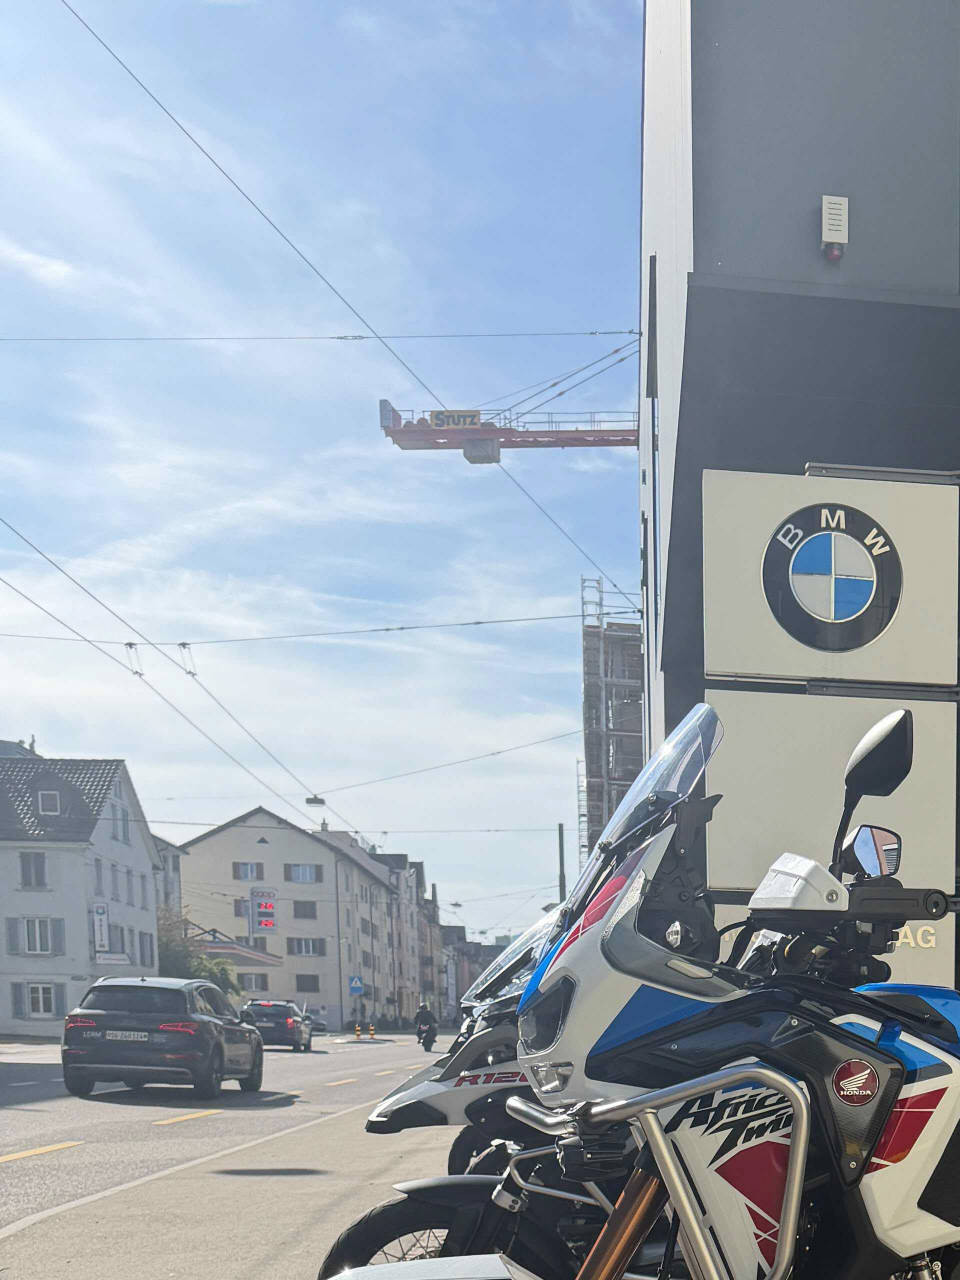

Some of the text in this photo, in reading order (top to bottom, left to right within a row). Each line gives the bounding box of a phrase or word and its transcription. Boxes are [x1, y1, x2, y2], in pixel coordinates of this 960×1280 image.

[434, 413, 478, 428] STUTZ
[776, 508, 891, 556] BMW
[897, 925, 937, 949] AG
